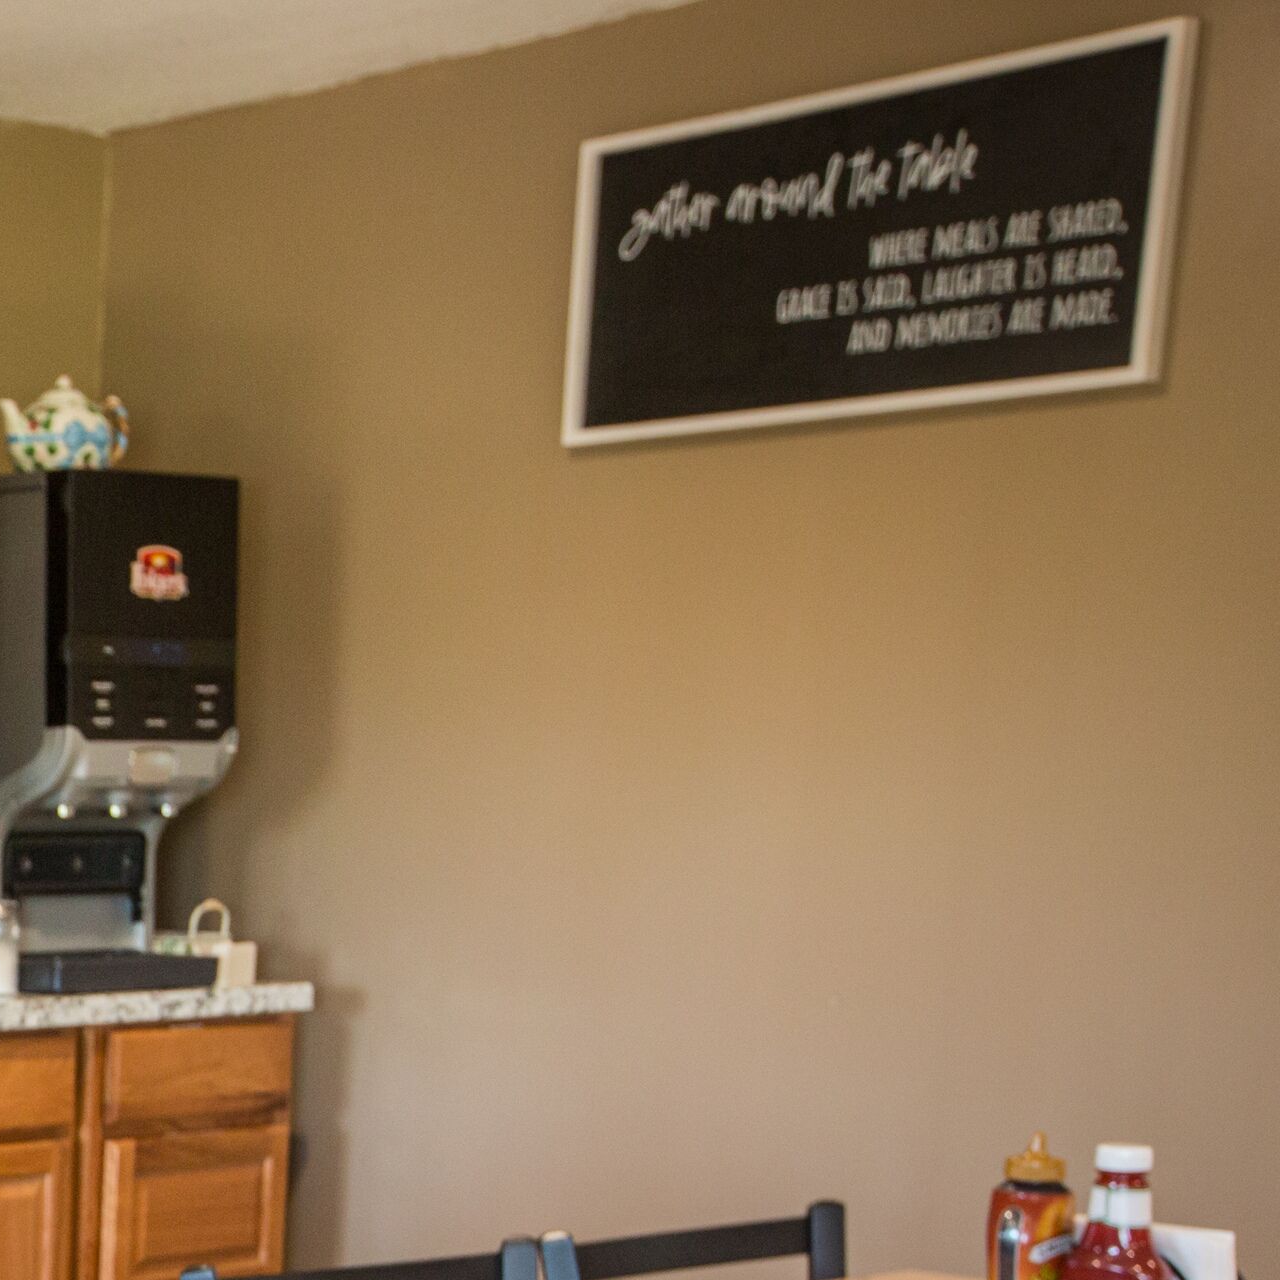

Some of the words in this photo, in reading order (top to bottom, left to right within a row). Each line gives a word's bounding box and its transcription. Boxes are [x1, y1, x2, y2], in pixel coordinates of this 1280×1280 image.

[618, 179, 721, 262] gather
[725, 151, 845, 222] around
[868, 226, 930, 270] WHERE
[931, 215, 1000, 261] MEALS
[1002, 208, 1043, 249] ARE
[776, 283, 832, 326] GRACE
[835, 278, 860, 317] IS
[920, 255, 1018, 305] LAUGHTER
[1022, 251, 1048, 291] IS
[845, 316, 893, 357] AND
[893, 301, 1004, 350] MEMORIES
[1005, 295, 1047, 336] ARE
